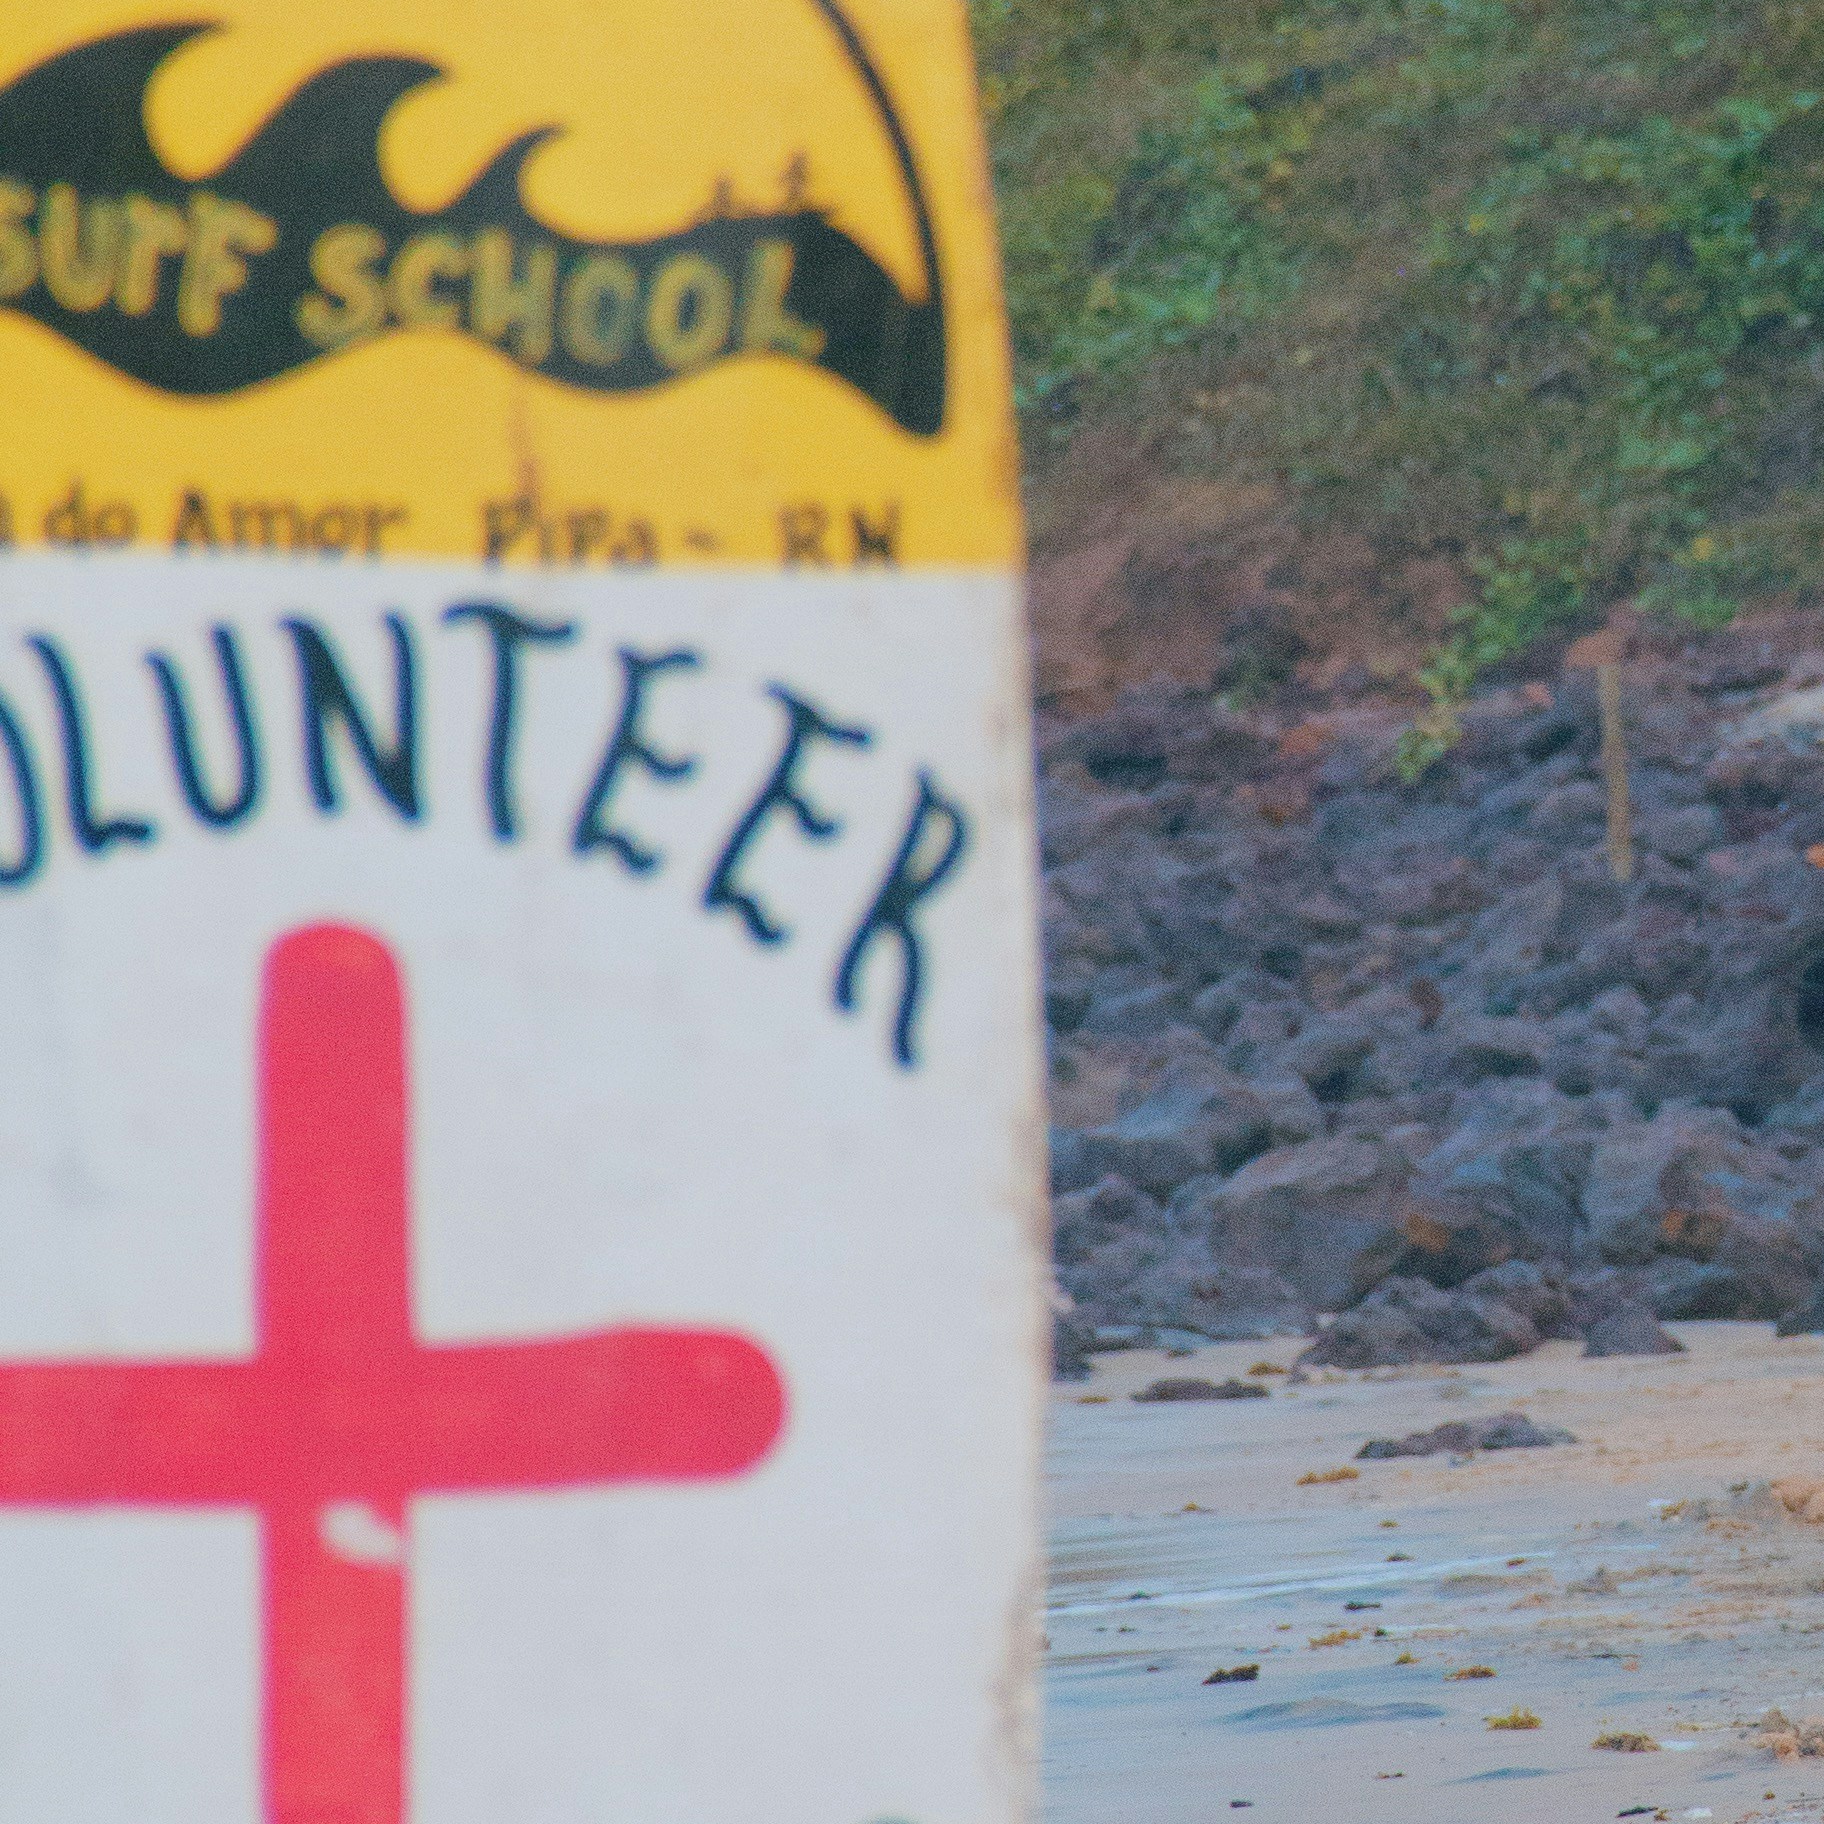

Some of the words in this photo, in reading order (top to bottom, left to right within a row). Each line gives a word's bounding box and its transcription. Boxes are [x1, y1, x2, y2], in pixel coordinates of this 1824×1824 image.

[298, 222, 824, 368] SCHOOL
[42, 476, 138, 553] do
[172, 484, 408, 560] Amor
